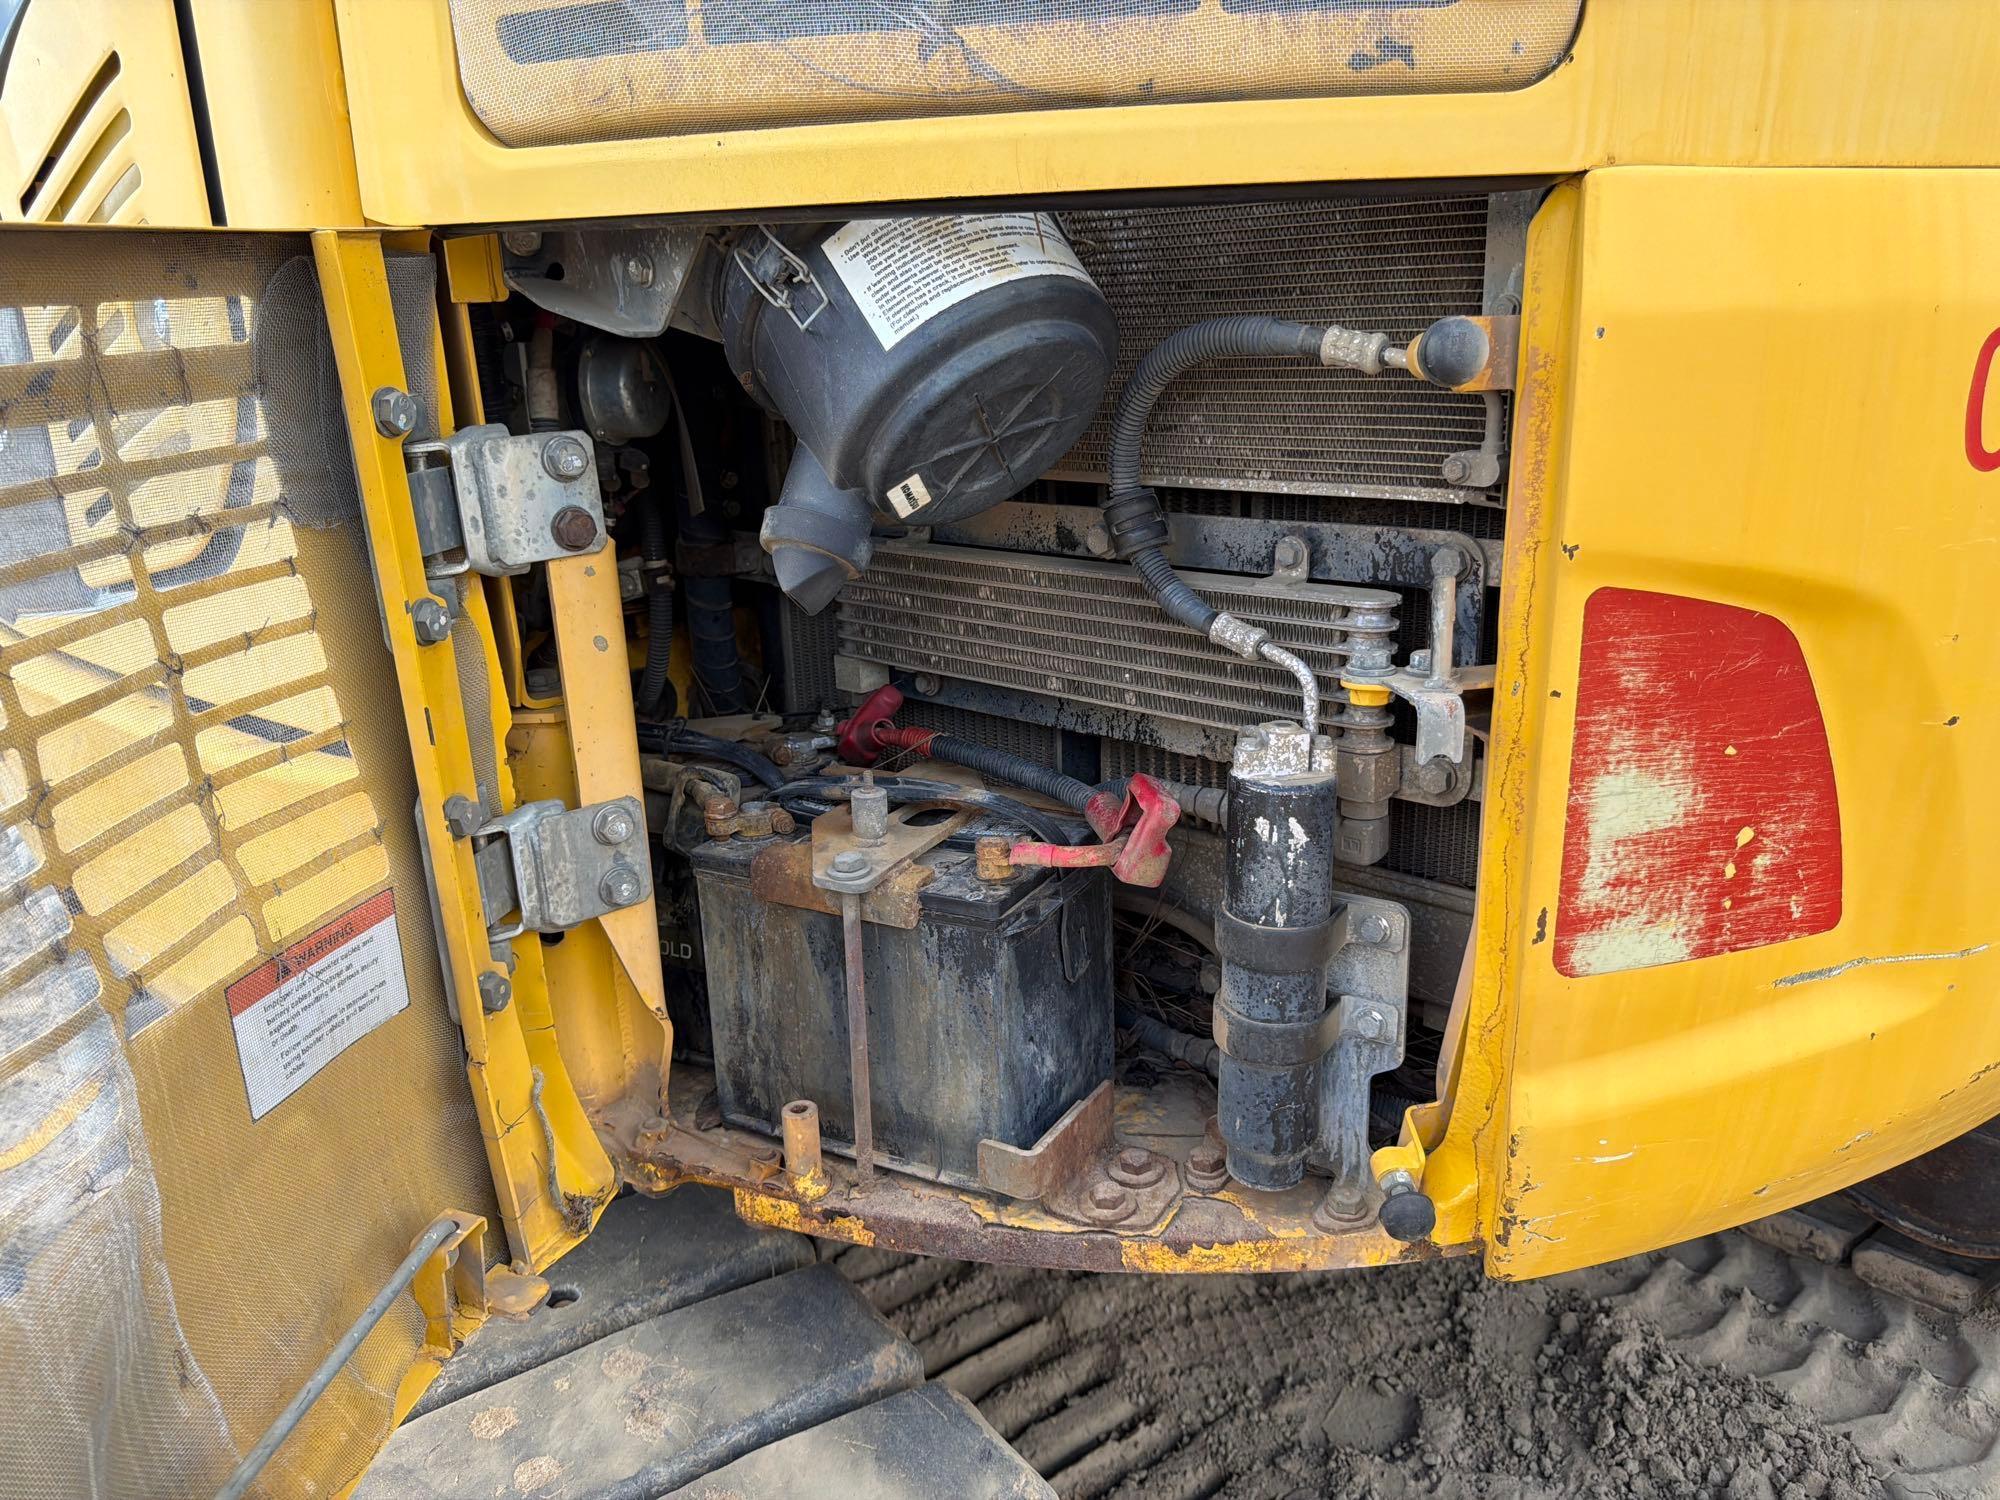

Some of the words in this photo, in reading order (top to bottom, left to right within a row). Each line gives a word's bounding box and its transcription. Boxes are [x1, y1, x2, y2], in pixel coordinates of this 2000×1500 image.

[848, 251, 860, 261] Use
[860, 242, 873, 253] only
[874, 227, 898, 243] genuine
[860, 234, 871, 244] put
[879, 222, 892, 231] into
[862, 246, 880, 259] When
[880, 231, 905, 247] warning
[866, 255, 878, 265] 250
[900, 233, 917, 243] clean
[917, 224, 933, 234] outer
[870, 260, 883, 270] One
[884, 252, 896, 263] year
[897, 243, 911, 253] after
[912, 229, 942, 245] exchange
[871, 269, 896, 287] warning
[895, 251, 926, 270] indication
[927, 244, 942, 253] does
[954, 233, 973, 241] return
[871, 284, 887, 297] clean
[887, 275, 899, 286] and
[899, 268, 912, 277] also
[920, 255, 935, 265] case
[943, 242, 966, 253] lacking
[966, 236, 984, 244] power
[874, 263, 892, 277] renew
[892, 253, 908, 264] inner
[909, 245, 921, 254] and
[922, 238, 938, 247] outer
[885, 295, 897, 305] this
[963, 252, 980, 260] clean
[875, 291, 890, 304] outer
[891, 273, 918, 292] elements
[918, 263, 934, 275] shall
[883, 296, 906, 316] Element
[907, 287, 923, 298] must
[931, 273, 946, 283] kept
[945, 267, 959, 275] free
[969, 256, 989, 265] cracks
[892, 300, 915, 318] element
[915, 293, 927, 301] has
[957, 268, 974, 278] must
[903, 300, 929, 319] cleaning
[929, 292, 941, 301] and
[941, 274, 980, 294] replacement
[900, 483, 920, 510] KOMATSU
[294, 921, 354, 966] WARNING
[362, 937, 374, 947] and
[266, 1007, 290, 1026] battery
[291, 991, 312, 1008] cables
[312, 982, 325, 993] can
[280, 1041, 302, 1059] Follow
[303, 1013, 338, 1041] instructions
[369, 980, 387, 993] when
[283, 1053, 301, 1070] using
[301, 1033, 324, 1055] booster
[326, 1018, 345, 1036] cables
[346, 1010, 358, 1021] and
